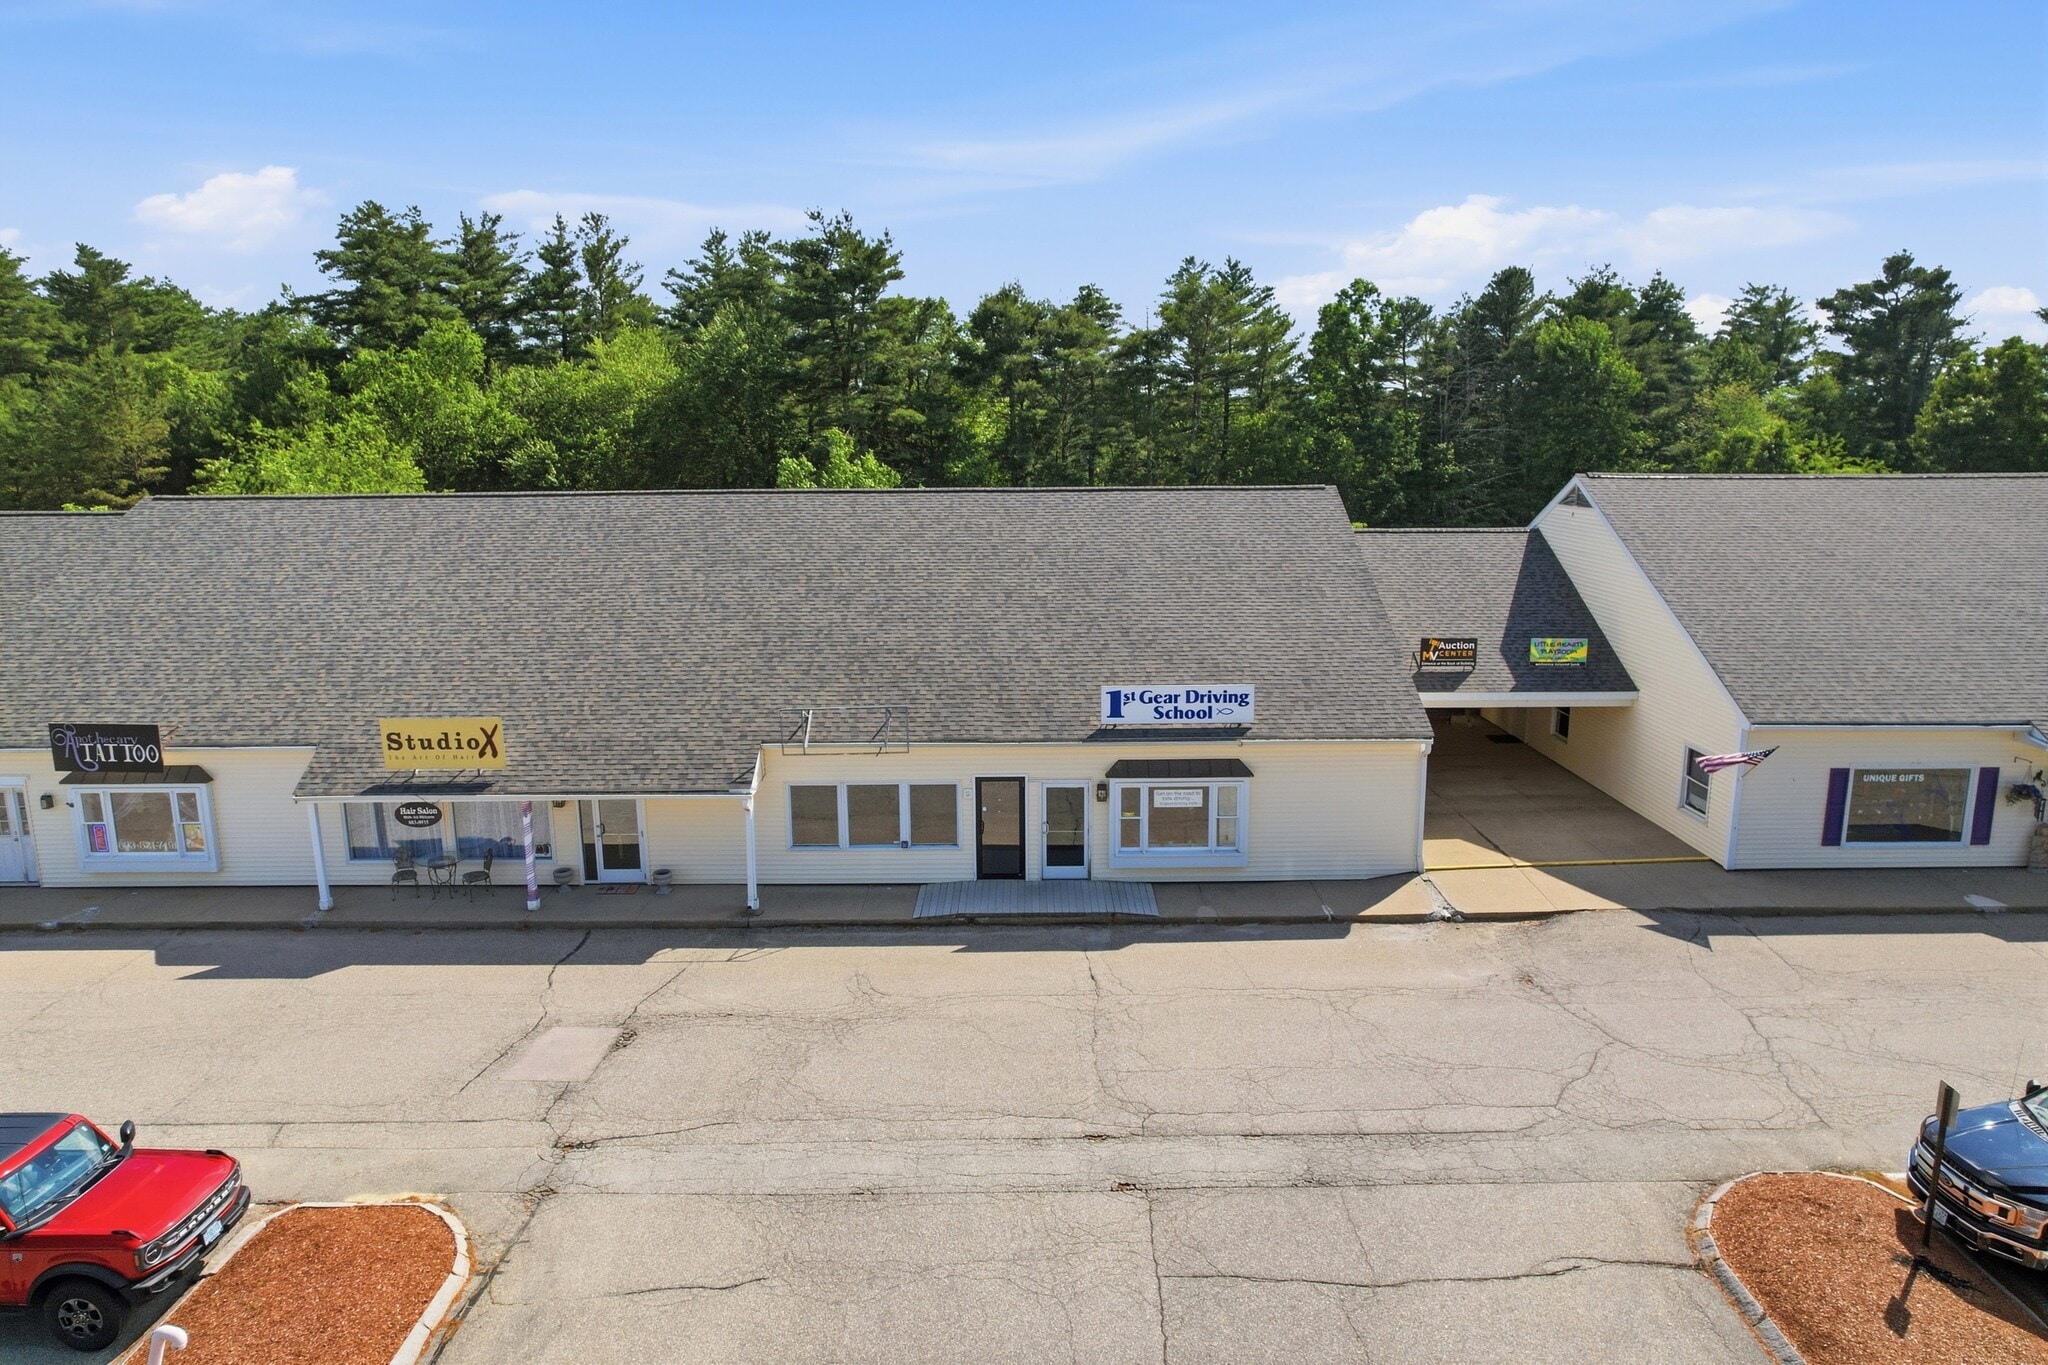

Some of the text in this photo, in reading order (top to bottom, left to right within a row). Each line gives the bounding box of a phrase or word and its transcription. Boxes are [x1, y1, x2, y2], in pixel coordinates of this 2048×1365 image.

[1438, 641, 1475, 650] Auction
[1422, 650, 1439, 661] MV
[1105, 689, 1250, 718] 1st Gear Driving
[1153, 705, 1213, 720] School
[79, 743, 160, 763] TATTOO
[1863, 774, 1925, 783] UNIQUE GIFTS
[399, 807, 438, 815] Hair Salon
